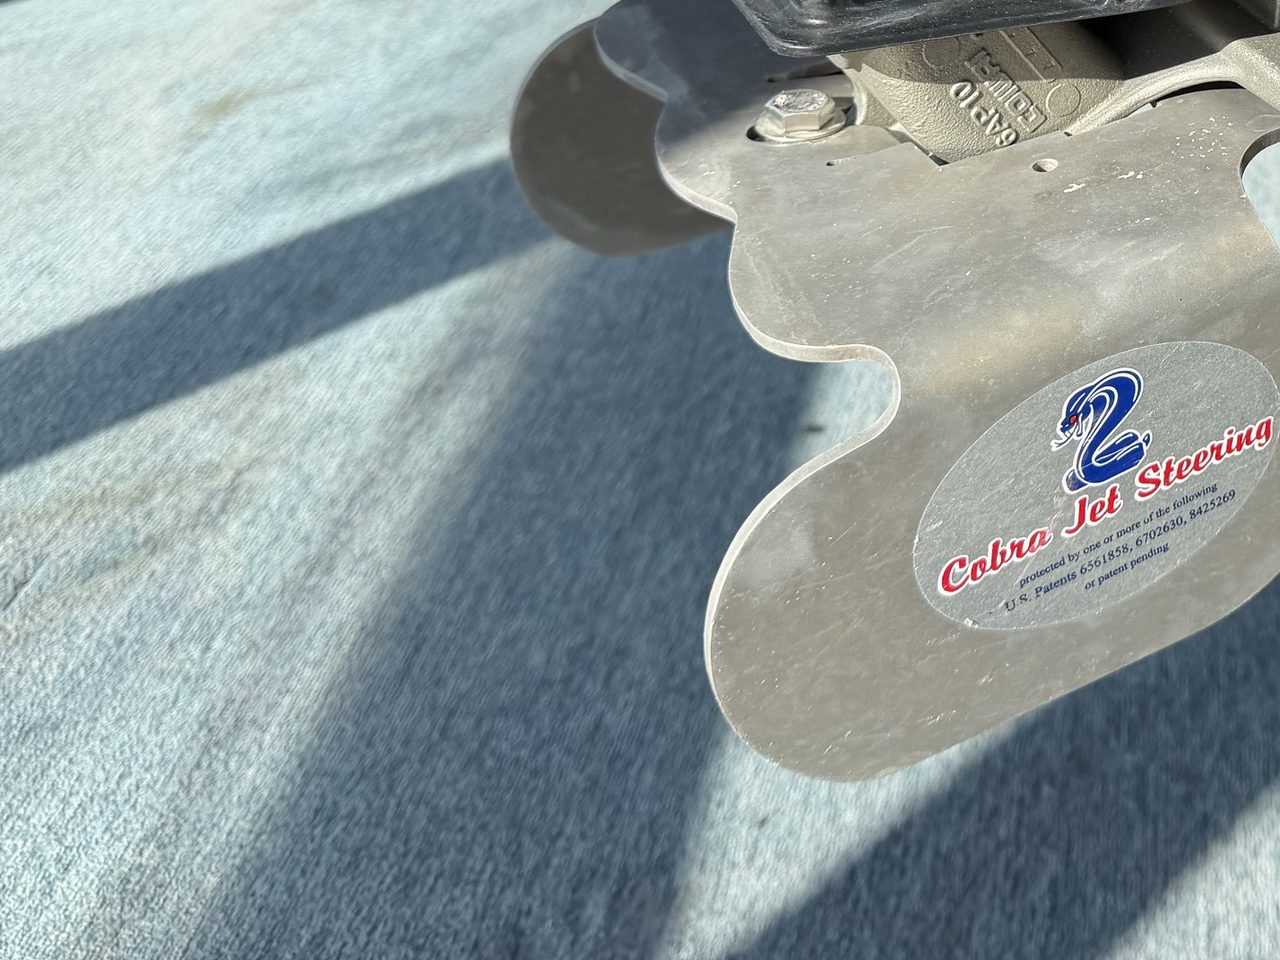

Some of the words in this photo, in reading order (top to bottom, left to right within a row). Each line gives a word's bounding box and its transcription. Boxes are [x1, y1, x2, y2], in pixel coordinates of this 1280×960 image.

[940, 527, 1052, 593] Cobra
[1064, 485, 1122, 534] Jet
[1137, 417, 1273, 498] Steering
[1004, 593, 1032, 612] U.S.
[1035, 570, 1077, 598] Patents
[1079, 543, 1133, 575] 6561858,
[1135, 516, 1187, 547] 6702630,
[1189, 489, 1236, 520] 8425269
[1019, 556, 1065, 588] protected
[1068, 550, 1080, 563] by
[1083, 543, 1101, 555] one
[1103, 534, 1114, 545] or
[1116, 520, 1141, 538] more
[1143, 508, 1155, 523] of
[1155, 505, 1171, 519] the
[1172, 483, 1218, 510] following
[1084, 578, 1095, 590] or
[1098, 563, 1128, 586] patent
[1130, 541, 1169, 570] pending
